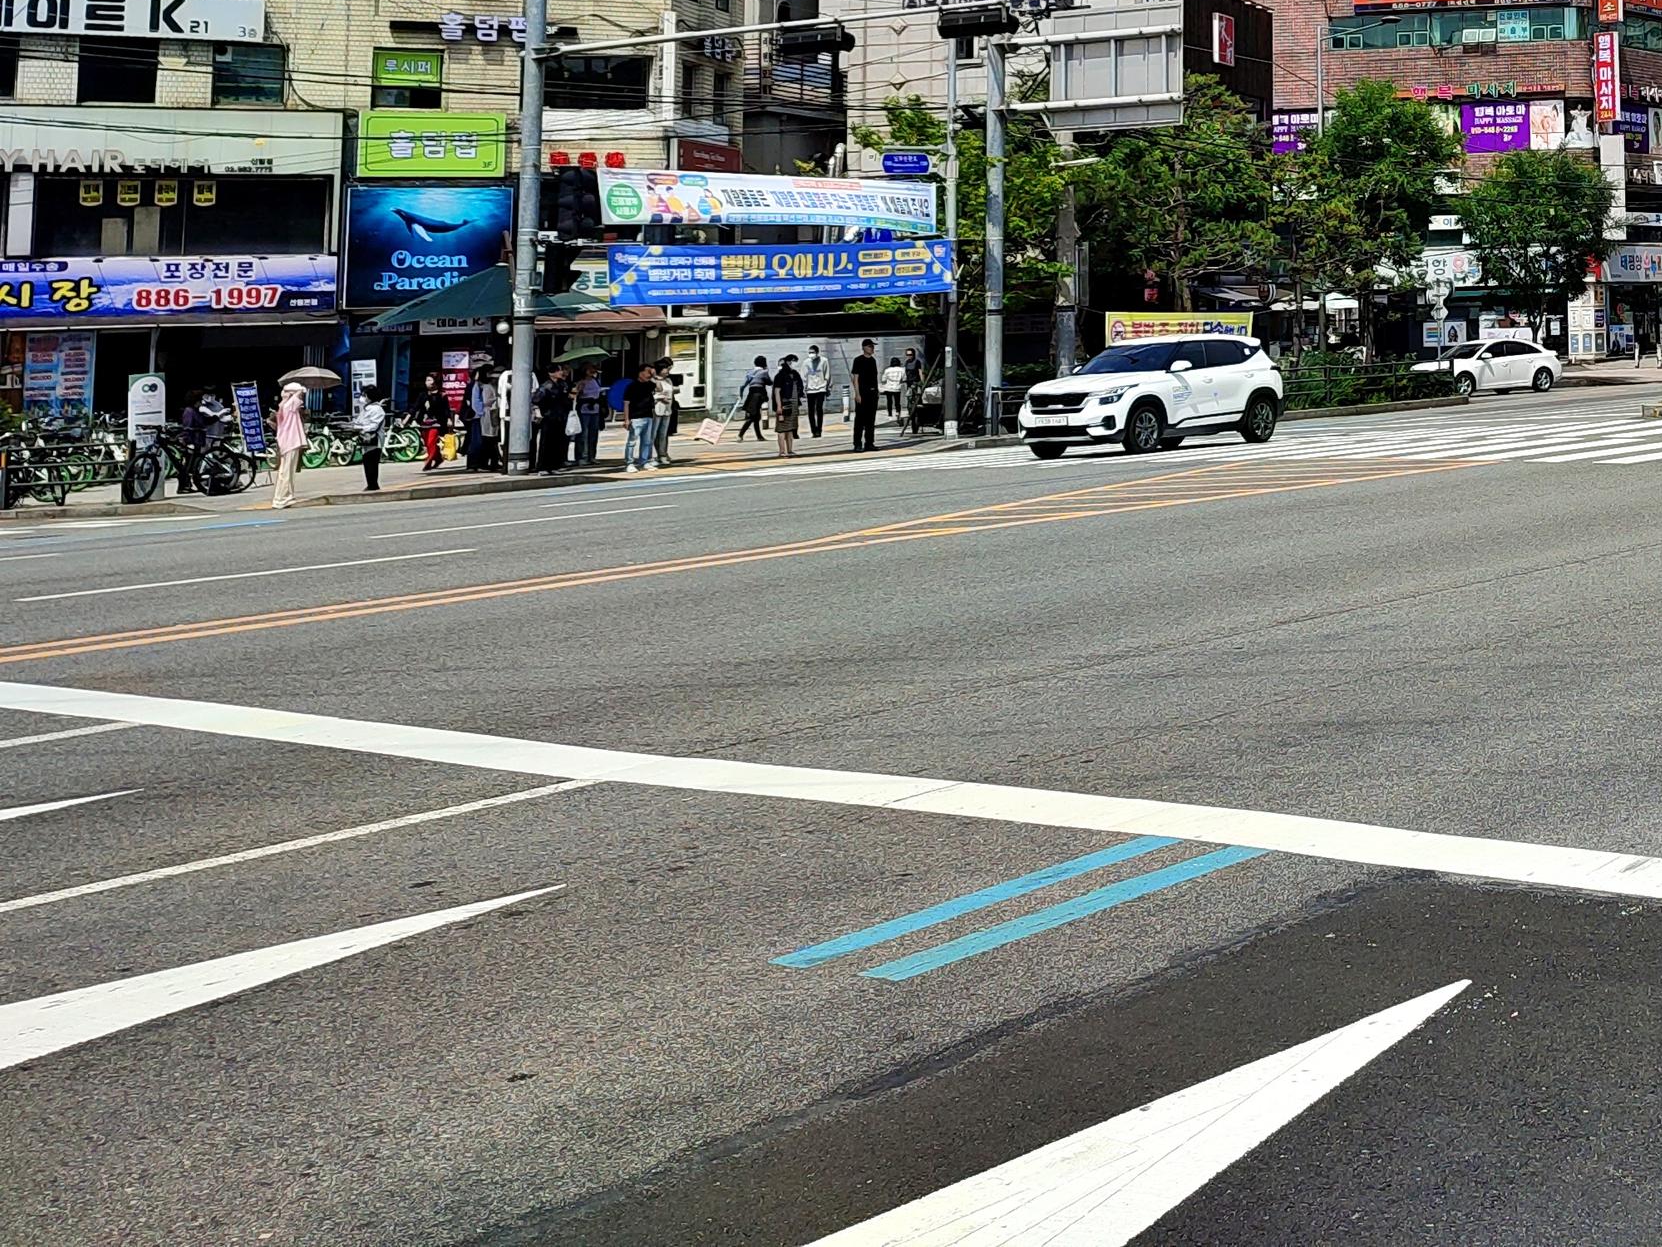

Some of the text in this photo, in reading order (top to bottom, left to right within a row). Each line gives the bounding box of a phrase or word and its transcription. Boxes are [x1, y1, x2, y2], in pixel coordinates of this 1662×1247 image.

[384, 58, 432, 75] 루시퍼
[1466, 80, 1518, 99] 마사지
[1599, 66, 1615, 111] 마사지
[31, 148, 126, 174] HAIR
[391, 250, 469, 269] Ocean
[163, 260, 256, 281] 포장전문
[135, 286, 281, 308] 886-1997
